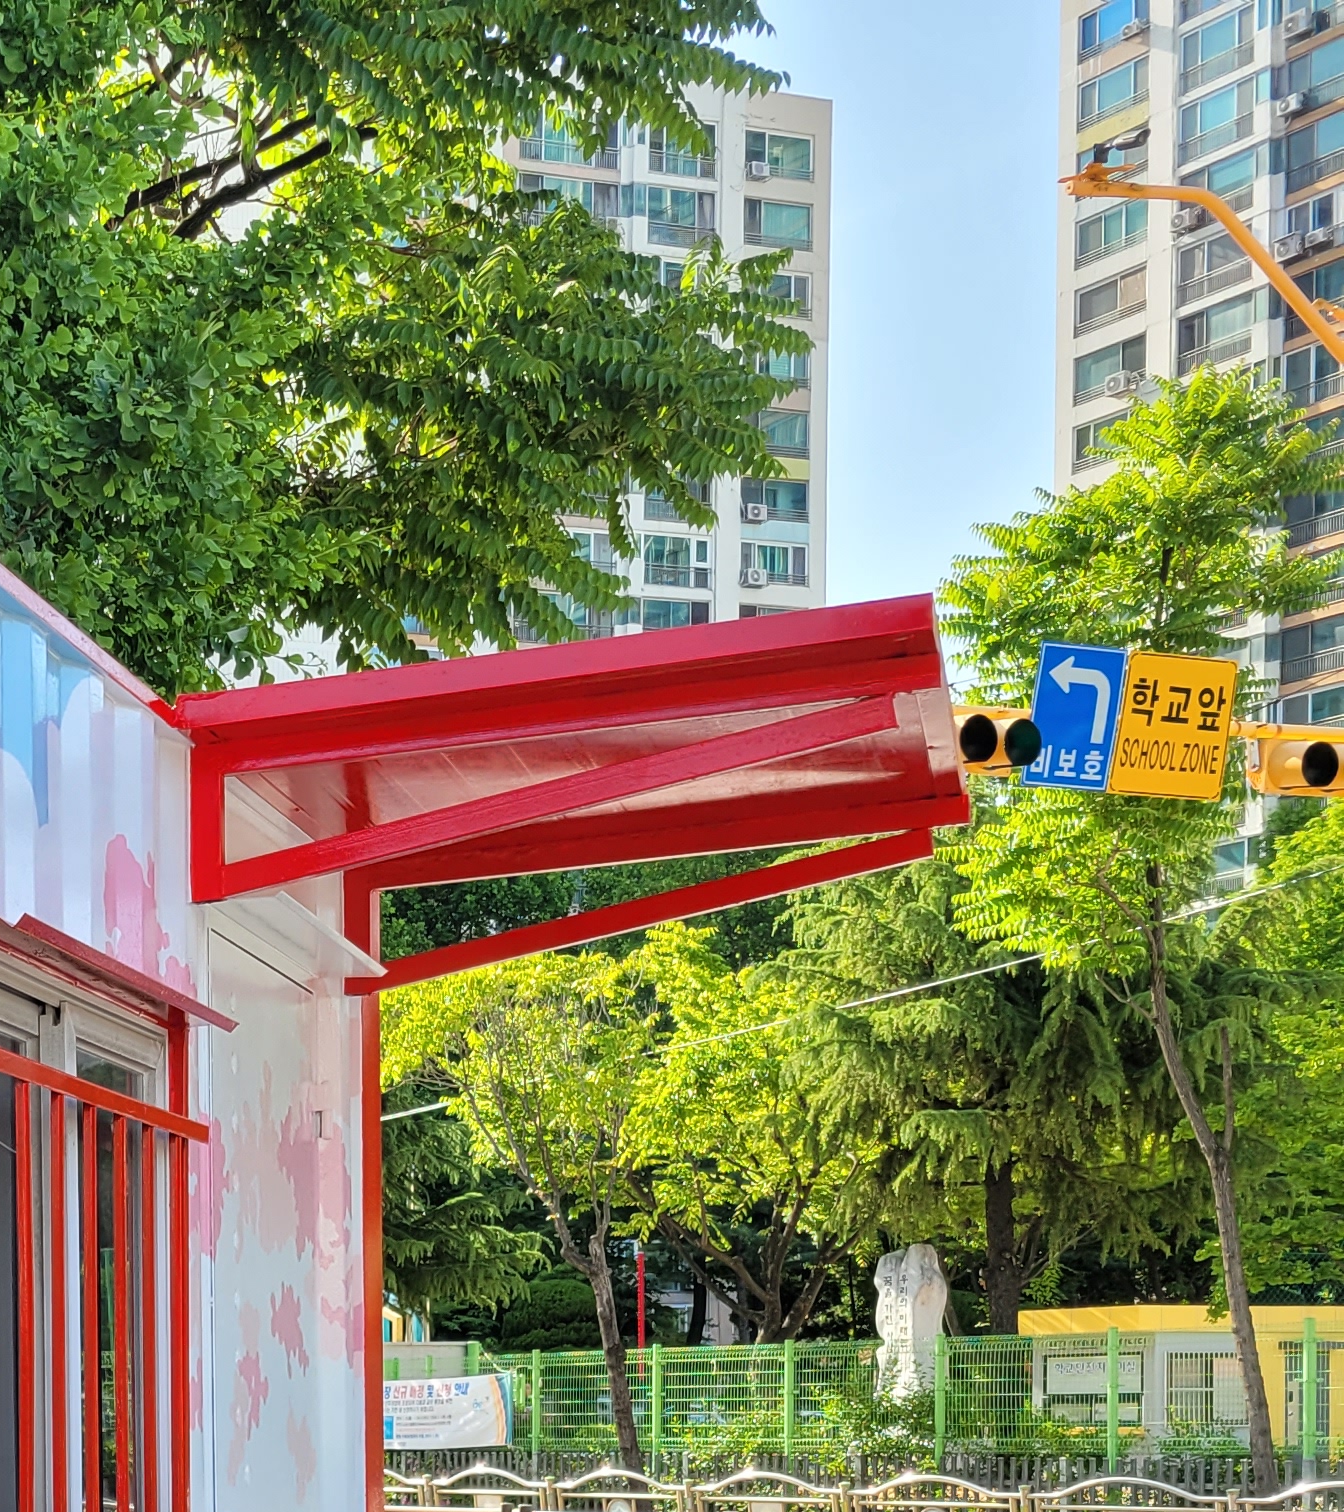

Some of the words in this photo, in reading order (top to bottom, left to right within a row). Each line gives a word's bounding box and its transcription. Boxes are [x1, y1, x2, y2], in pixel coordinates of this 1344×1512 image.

[1130, 677, 1227, 732] 학교앞
[1029, 744, 1105, 781] 비보호
[1119, 737, 1176, 772] SCHOOL
[1178, 743, 1221, 775] ZONE
[1054, 1359, 1136, 1375] 학교안전지이실
[393, 1385, 408, 1399] 신규
